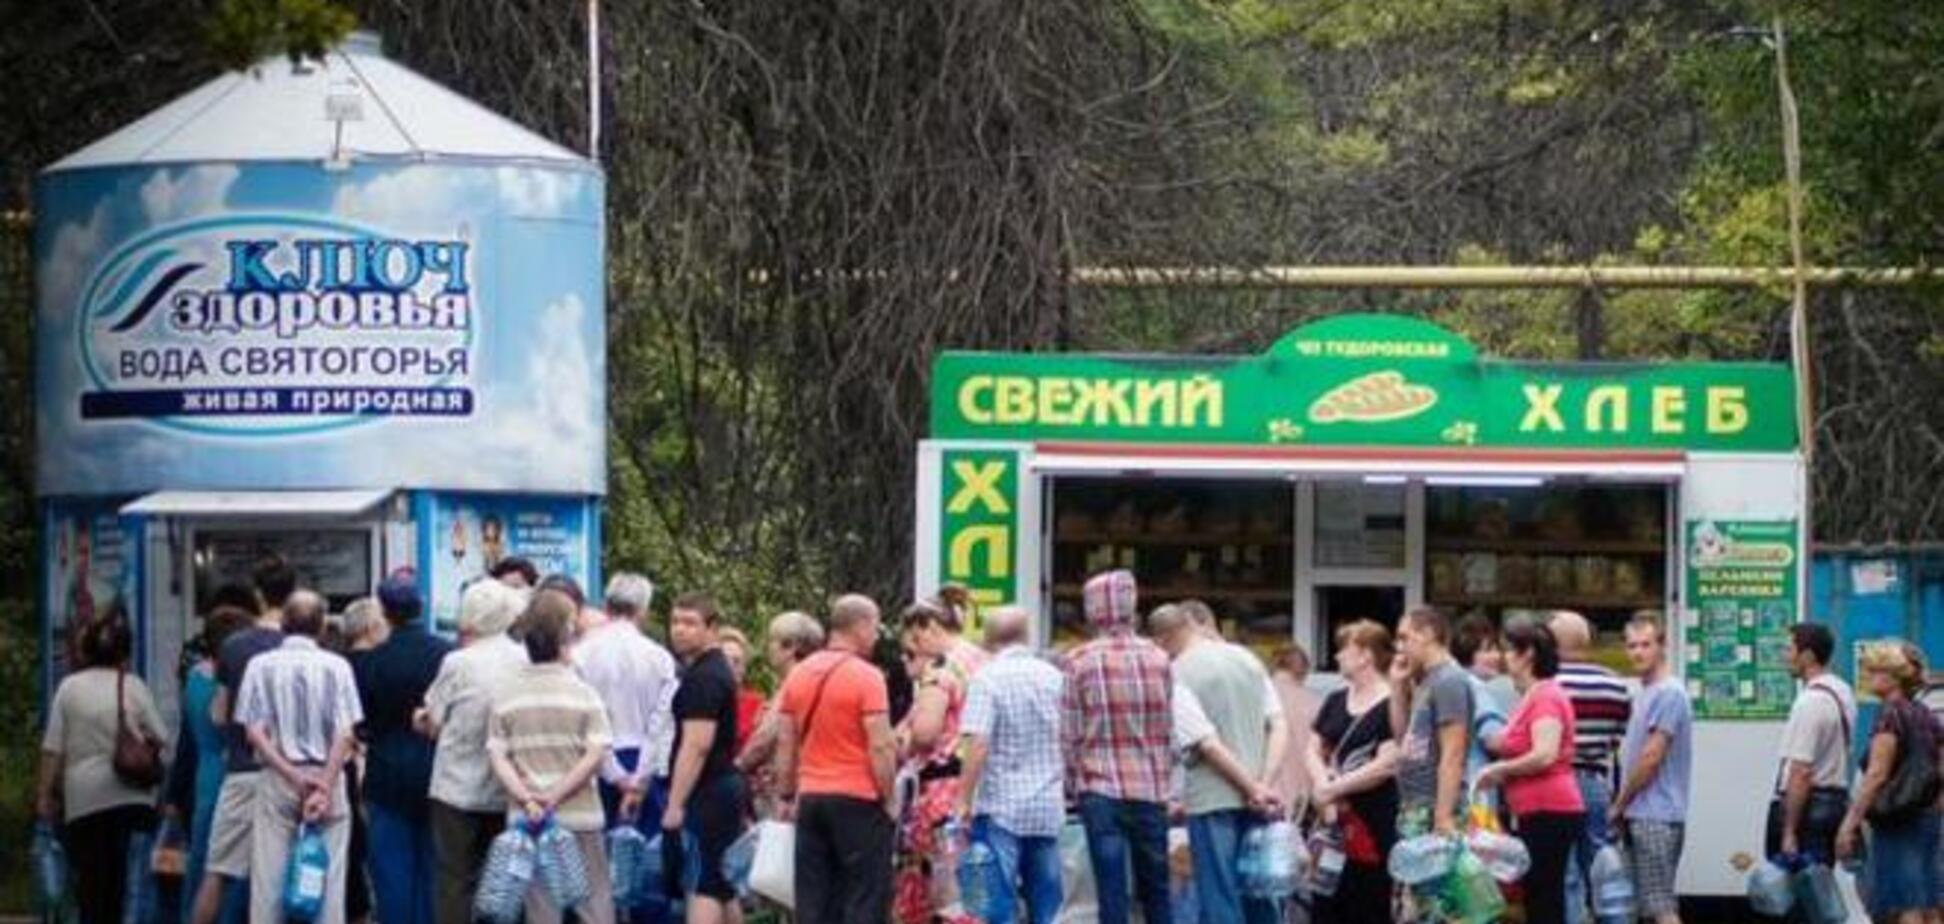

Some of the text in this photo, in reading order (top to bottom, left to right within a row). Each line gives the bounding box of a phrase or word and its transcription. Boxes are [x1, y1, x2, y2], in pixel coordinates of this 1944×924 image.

[226, 240, 470, 292] КЛЮЧ
[119, 346, 469, 381] ВОДА СВЯТОГОРЬЯ
[182, 387, 464, 414] живая природная
[957, 374, 1749, 434] СВЕЖИЙ ХЛЕБ
